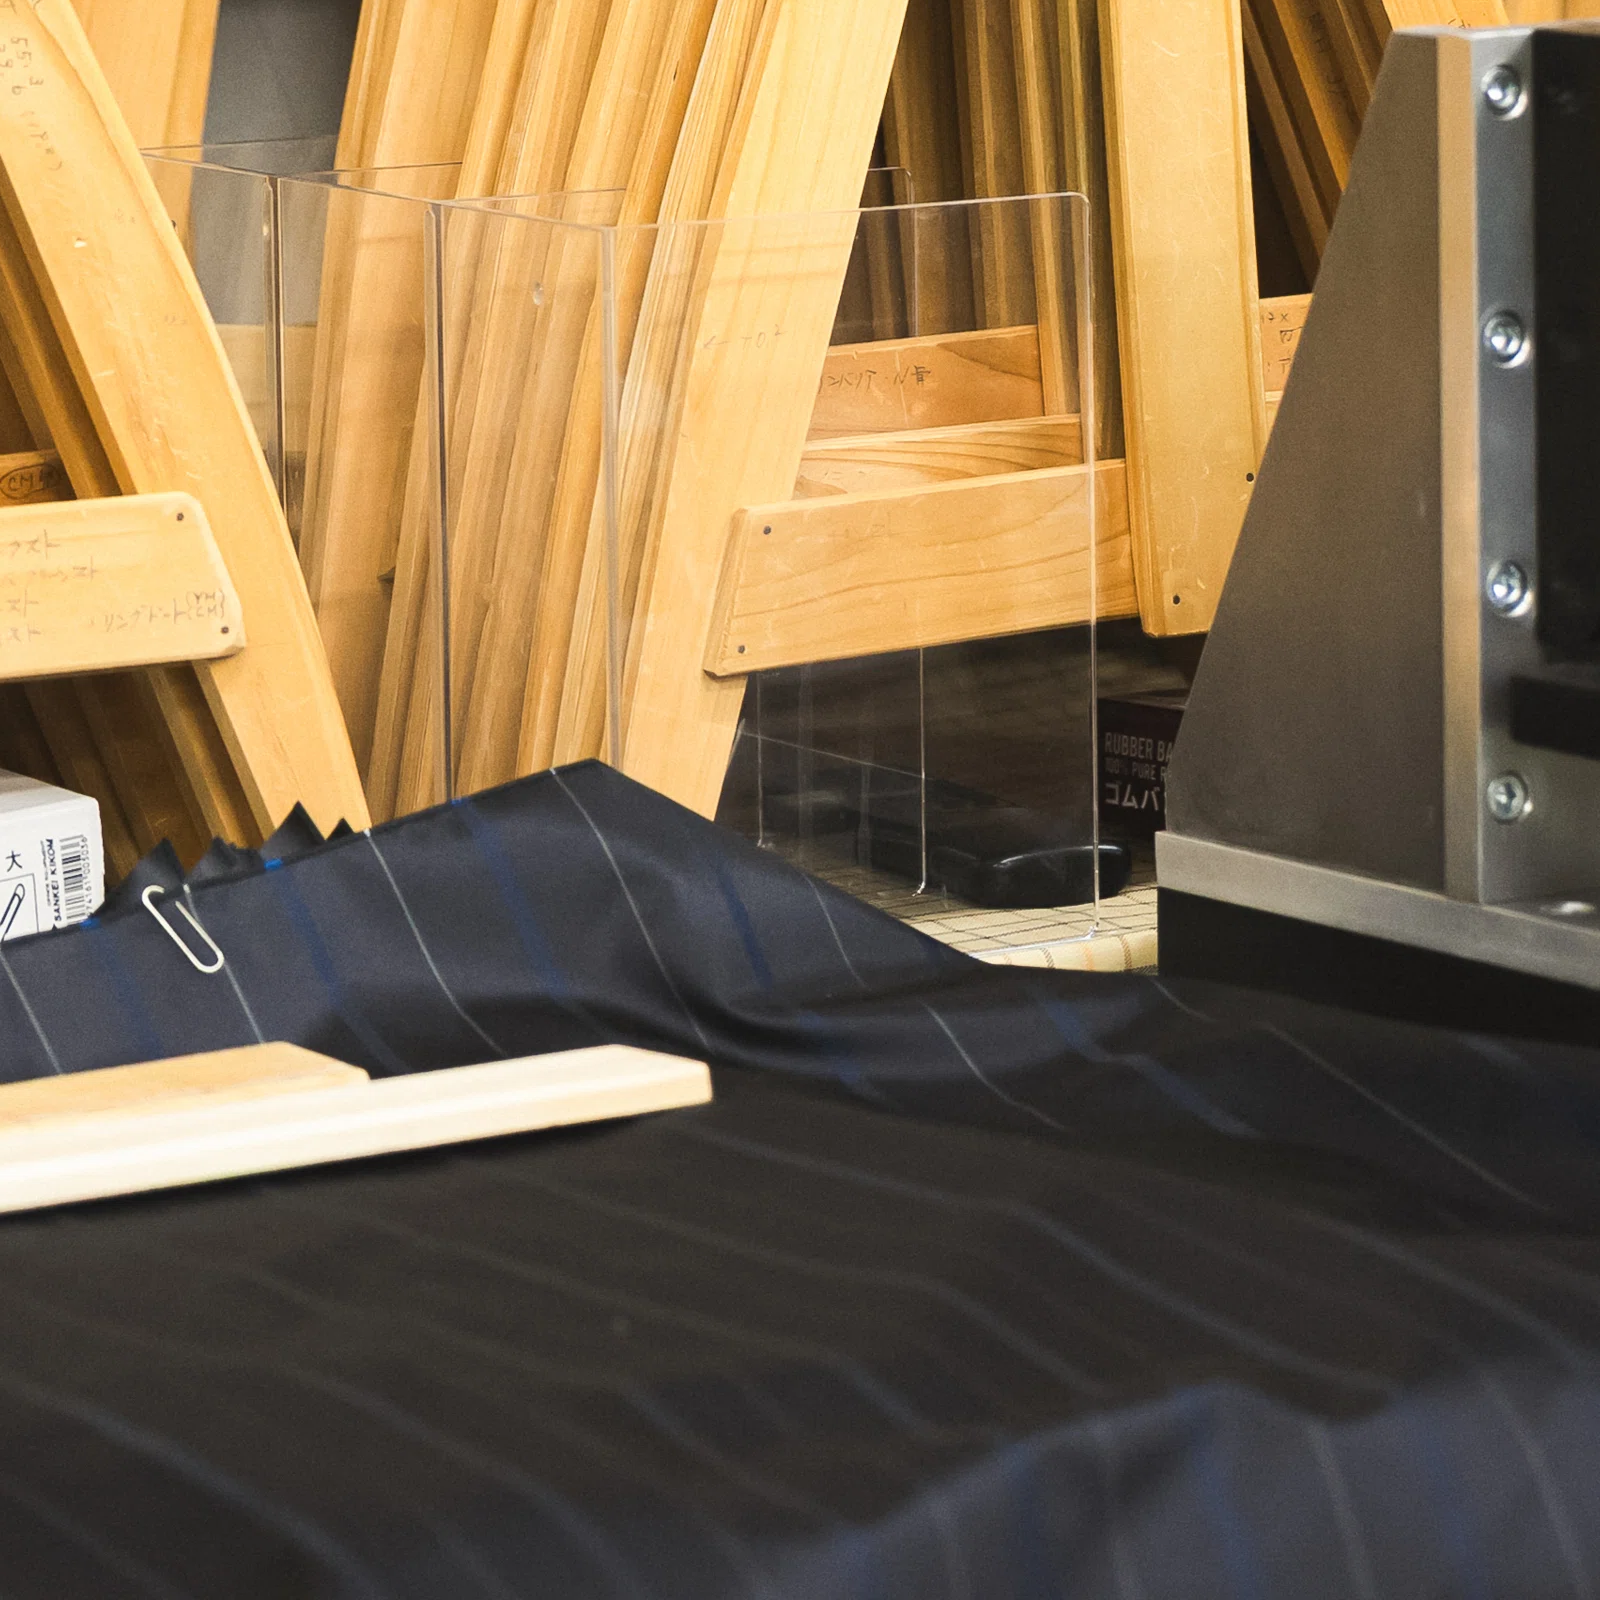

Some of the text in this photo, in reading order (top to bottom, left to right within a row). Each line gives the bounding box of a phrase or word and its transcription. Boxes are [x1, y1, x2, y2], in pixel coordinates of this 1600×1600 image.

[1104, 732, 1153, 760] RUBBER
[1131, 761, 1157, 780] PURE
[5, 851, 23, 872] 大
